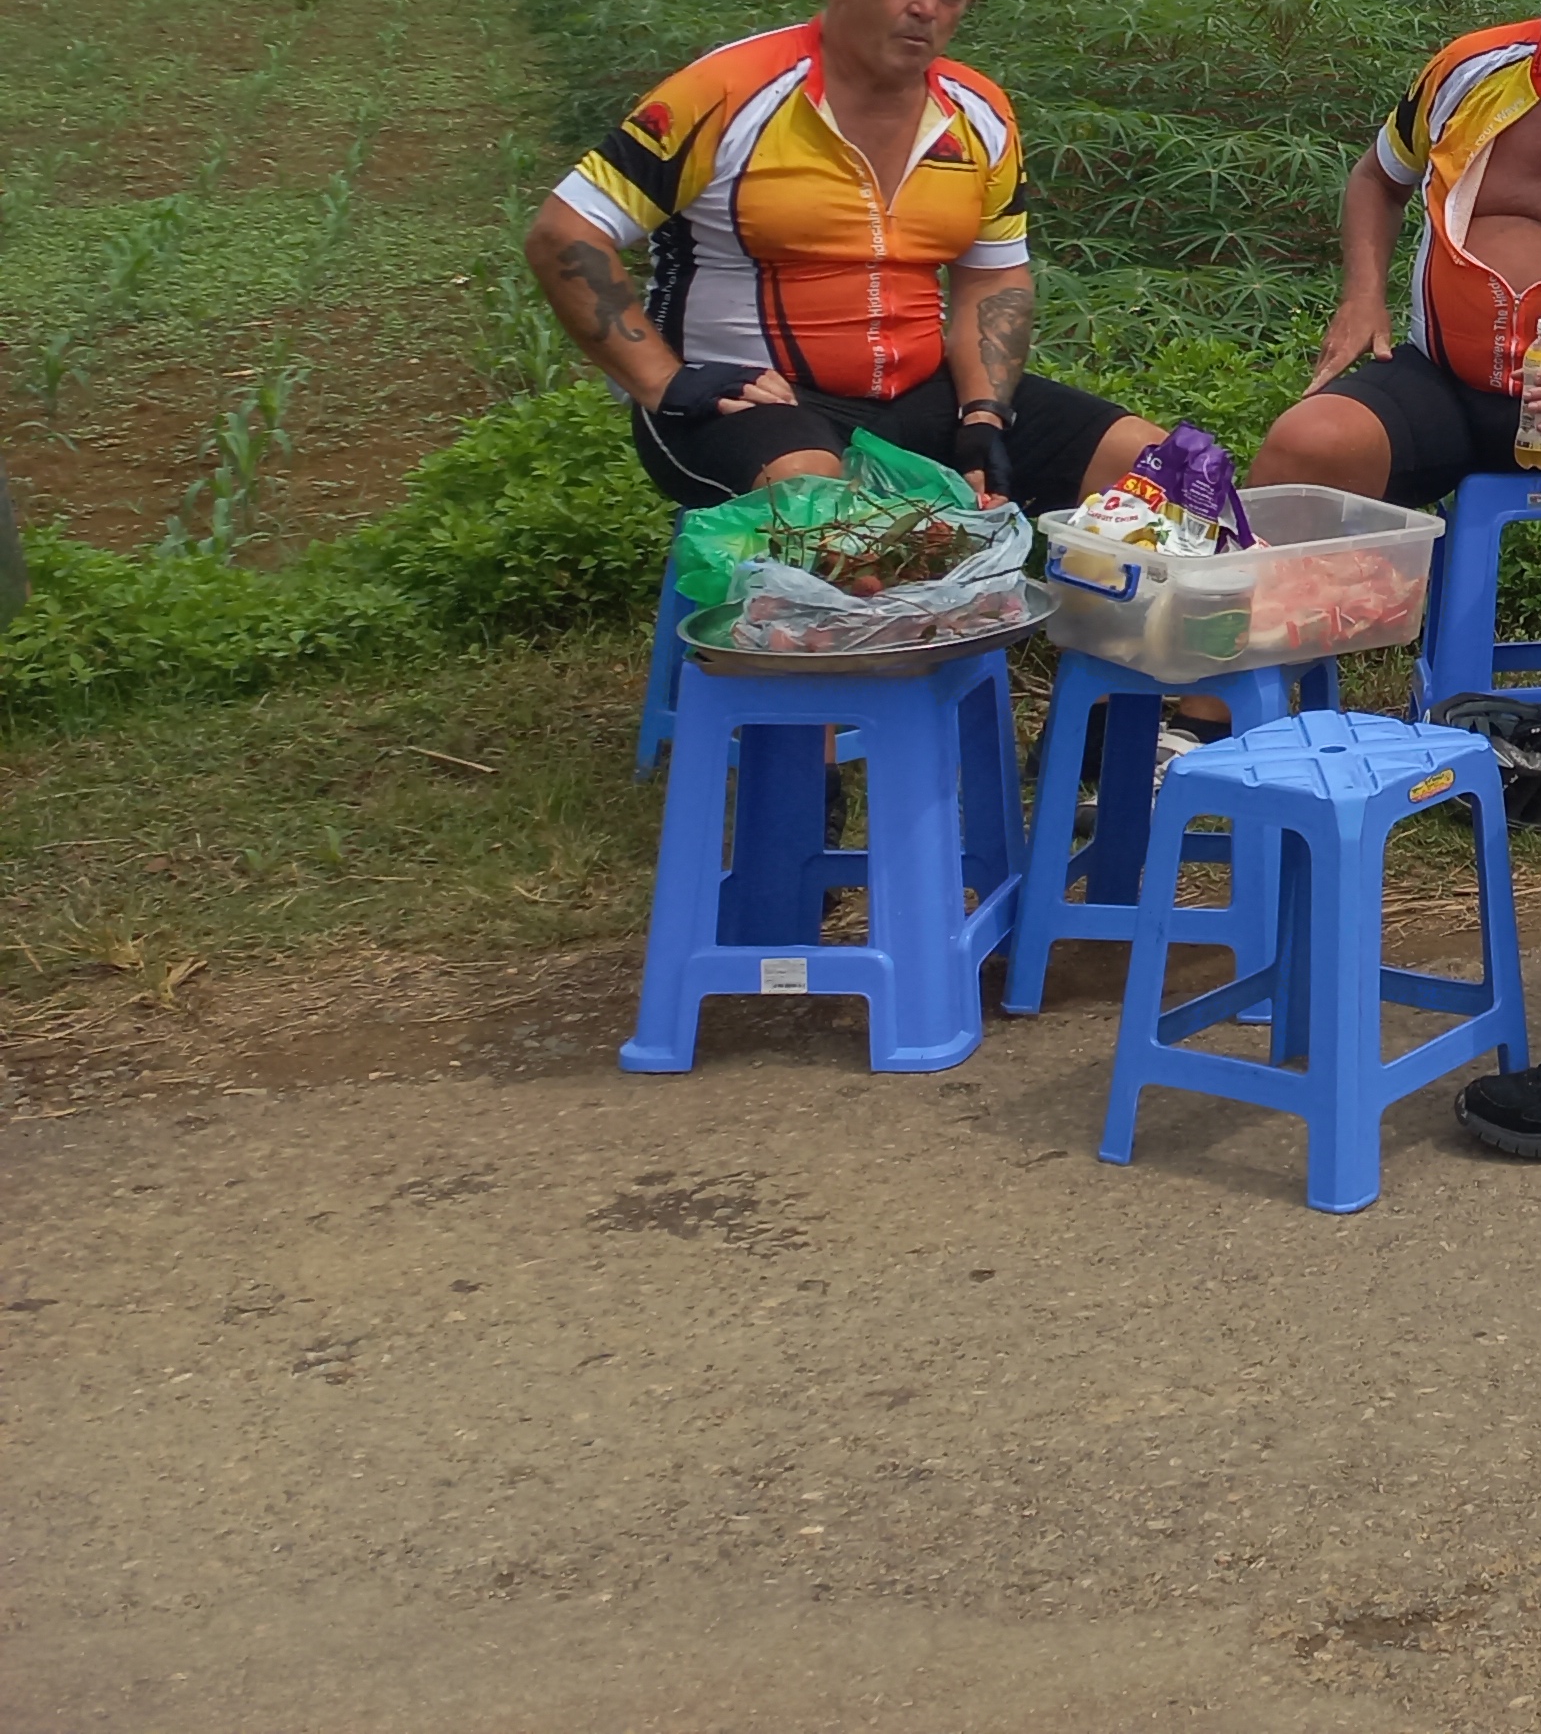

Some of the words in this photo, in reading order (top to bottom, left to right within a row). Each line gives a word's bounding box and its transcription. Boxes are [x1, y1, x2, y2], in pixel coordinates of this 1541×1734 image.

[866, 271, 883, 317] Hidden
[867, 318, 881, 343] The
[1493, 309, 1508, 331] The
[1490, 334, 1506, 388] Discovers
